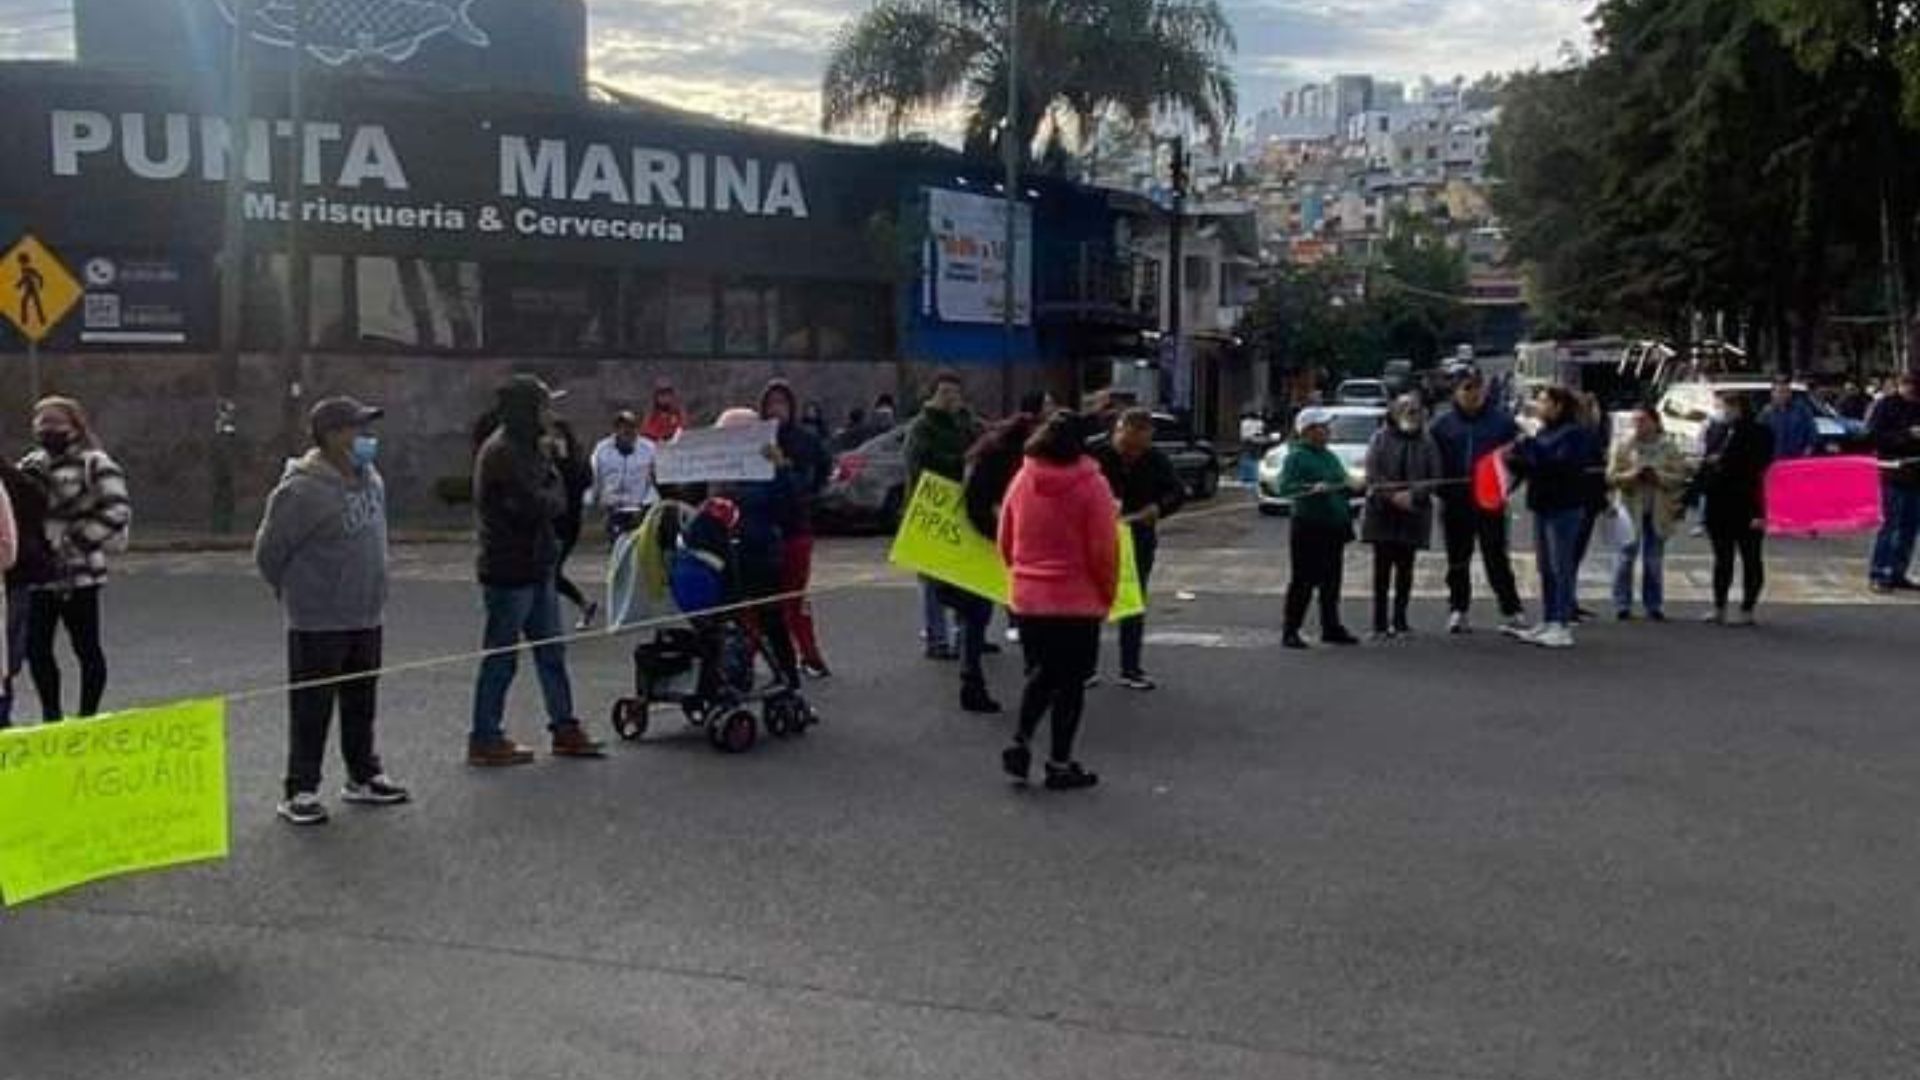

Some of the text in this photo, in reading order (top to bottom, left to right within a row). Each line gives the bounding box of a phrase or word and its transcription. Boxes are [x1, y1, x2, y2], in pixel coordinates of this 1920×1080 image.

[50, 109, 809, 218] PUNTA MARINA
[478, 205, 503, 231] &
